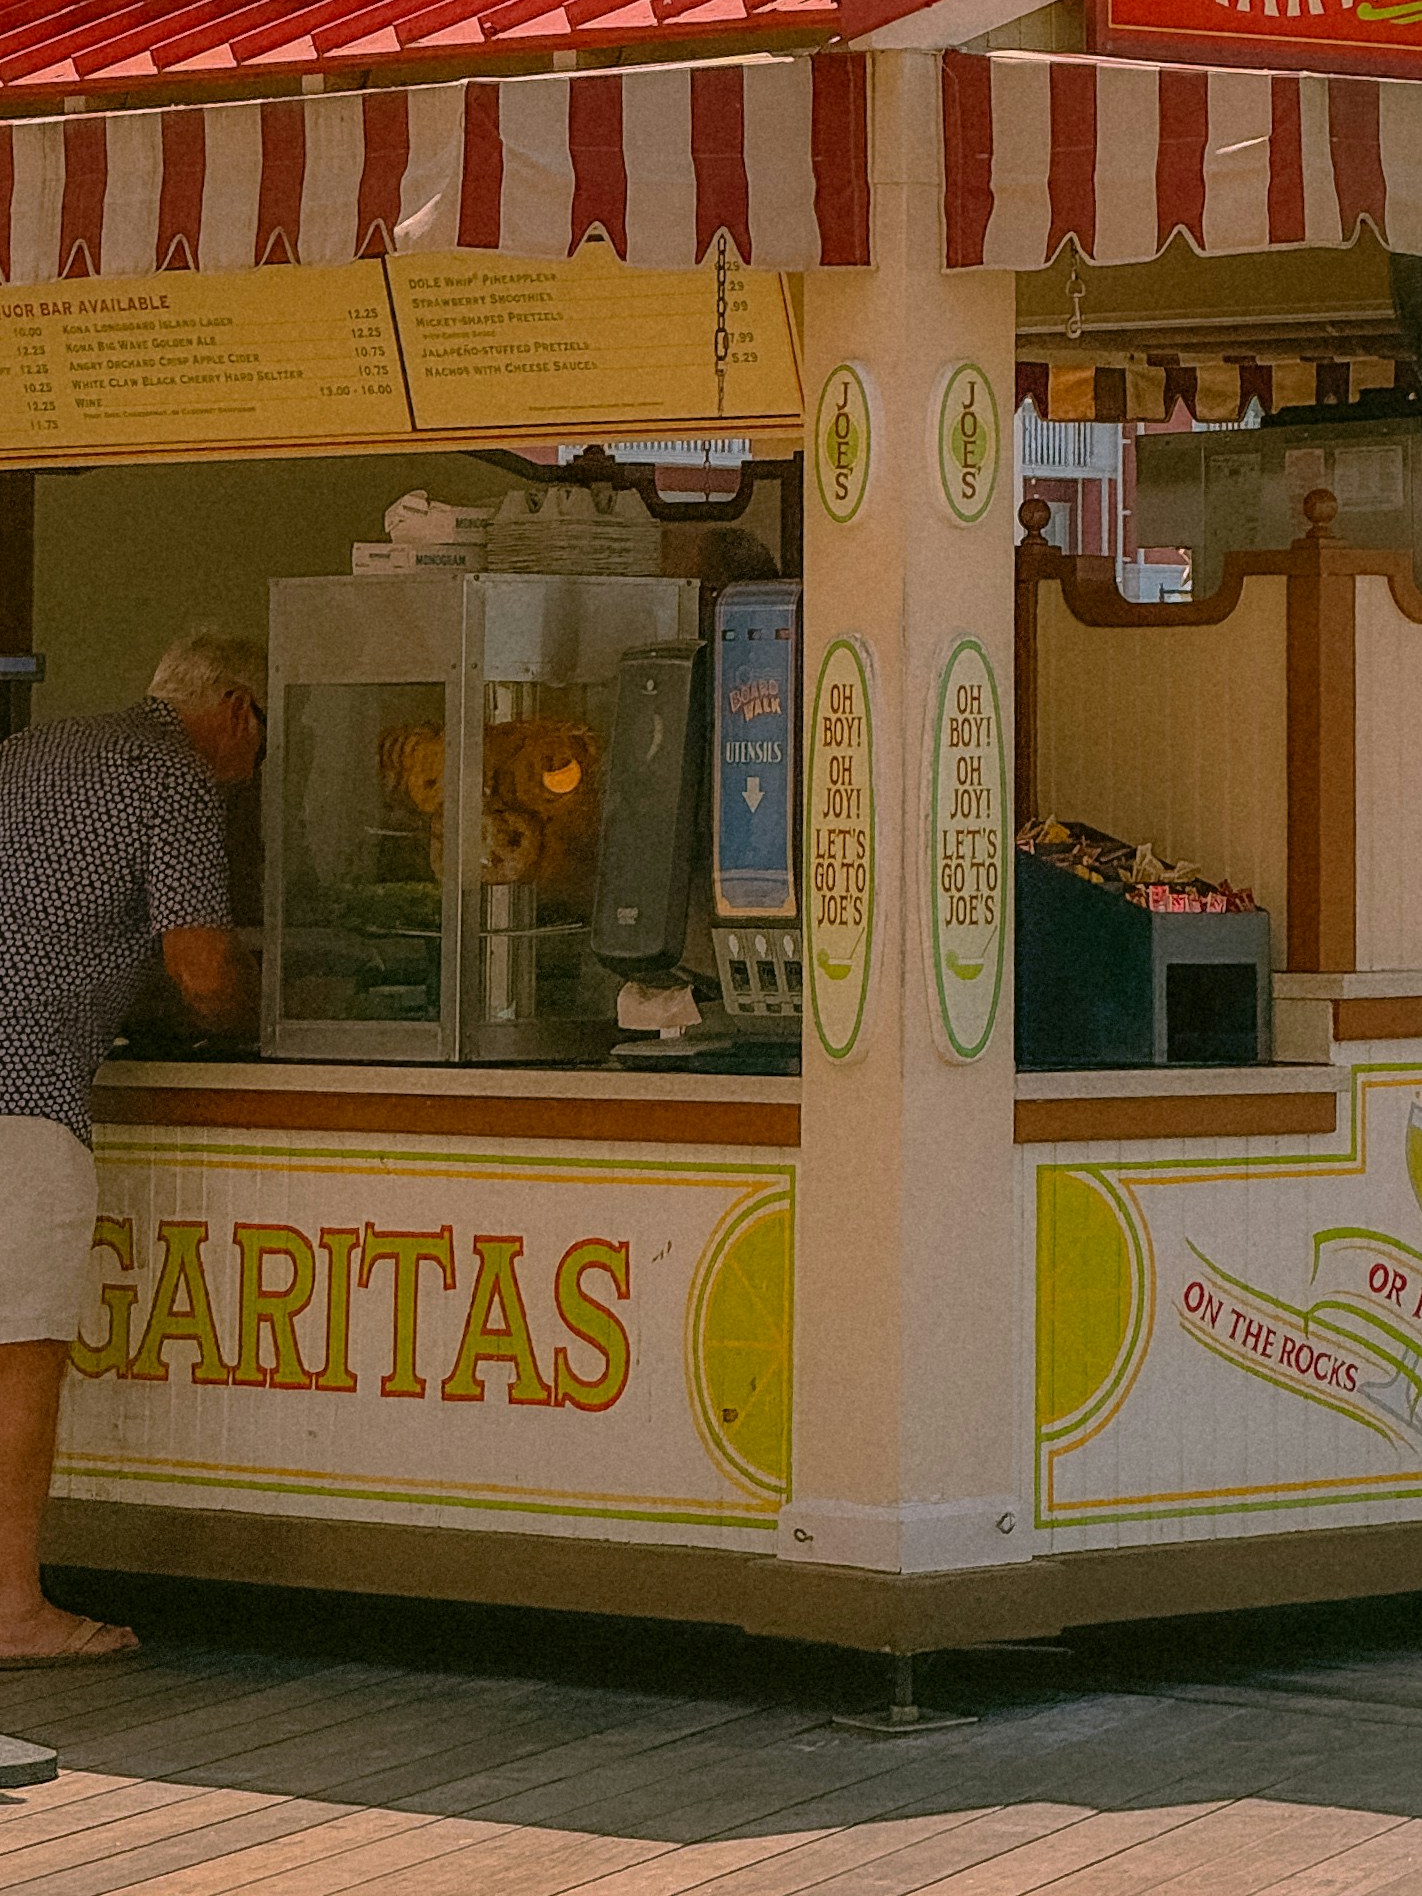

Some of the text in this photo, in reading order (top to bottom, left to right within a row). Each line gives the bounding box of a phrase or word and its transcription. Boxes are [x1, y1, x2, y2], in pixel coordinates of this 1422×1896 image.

[408, 277, 441, 289] DOLE
[0, 295, 170, 318] UOR BAR AVAILABLE
[348, 307, 379, 320] 12.25
[351, 326, 382, 338] 12.25
[355, 345, 386, 357] 10.75
[473, 364, 502, 376] WITH
[505, 362, 550, 374] CHEESE
[731, 351, 758, 364] 5.29
[359, 364, 389, 377] 10.75
[27, 401, 56, 412] 12.25
[835, 381, 854, 501] JOE'S
[961, 380, 982, 500] JOE'S
[730, 679, 779, 713] BOARD
[743, 697, 782, 722] WALK
[830, 684, 854, 715] OH
[956, 684, 983, 715] OH
[822, 716, 863, 748] BOY!
[949, 716, 992, 748] BOY!
[725, 741, 782, 763] UTENSILS
[829, 755, 853, 786] OH
[956, 756, 982, 786] OH
[822, 788, 862, 819] JOY!
[950, 788, 991, 820] JOY!
[815, 828, 866, 860] LET'S
[942, 827, 998, 860] LET'S
[814, 862, 866, 893] GO TO
[941, 862, 998, 893] GO TO
[817, 894, 863, 928] JOE'S
[945, 893, 995, 928] JOE'S
[1369, 1263, 1407, 1307] OR
[1183, 1281, 1358, 1392] ON THE ROCKS
